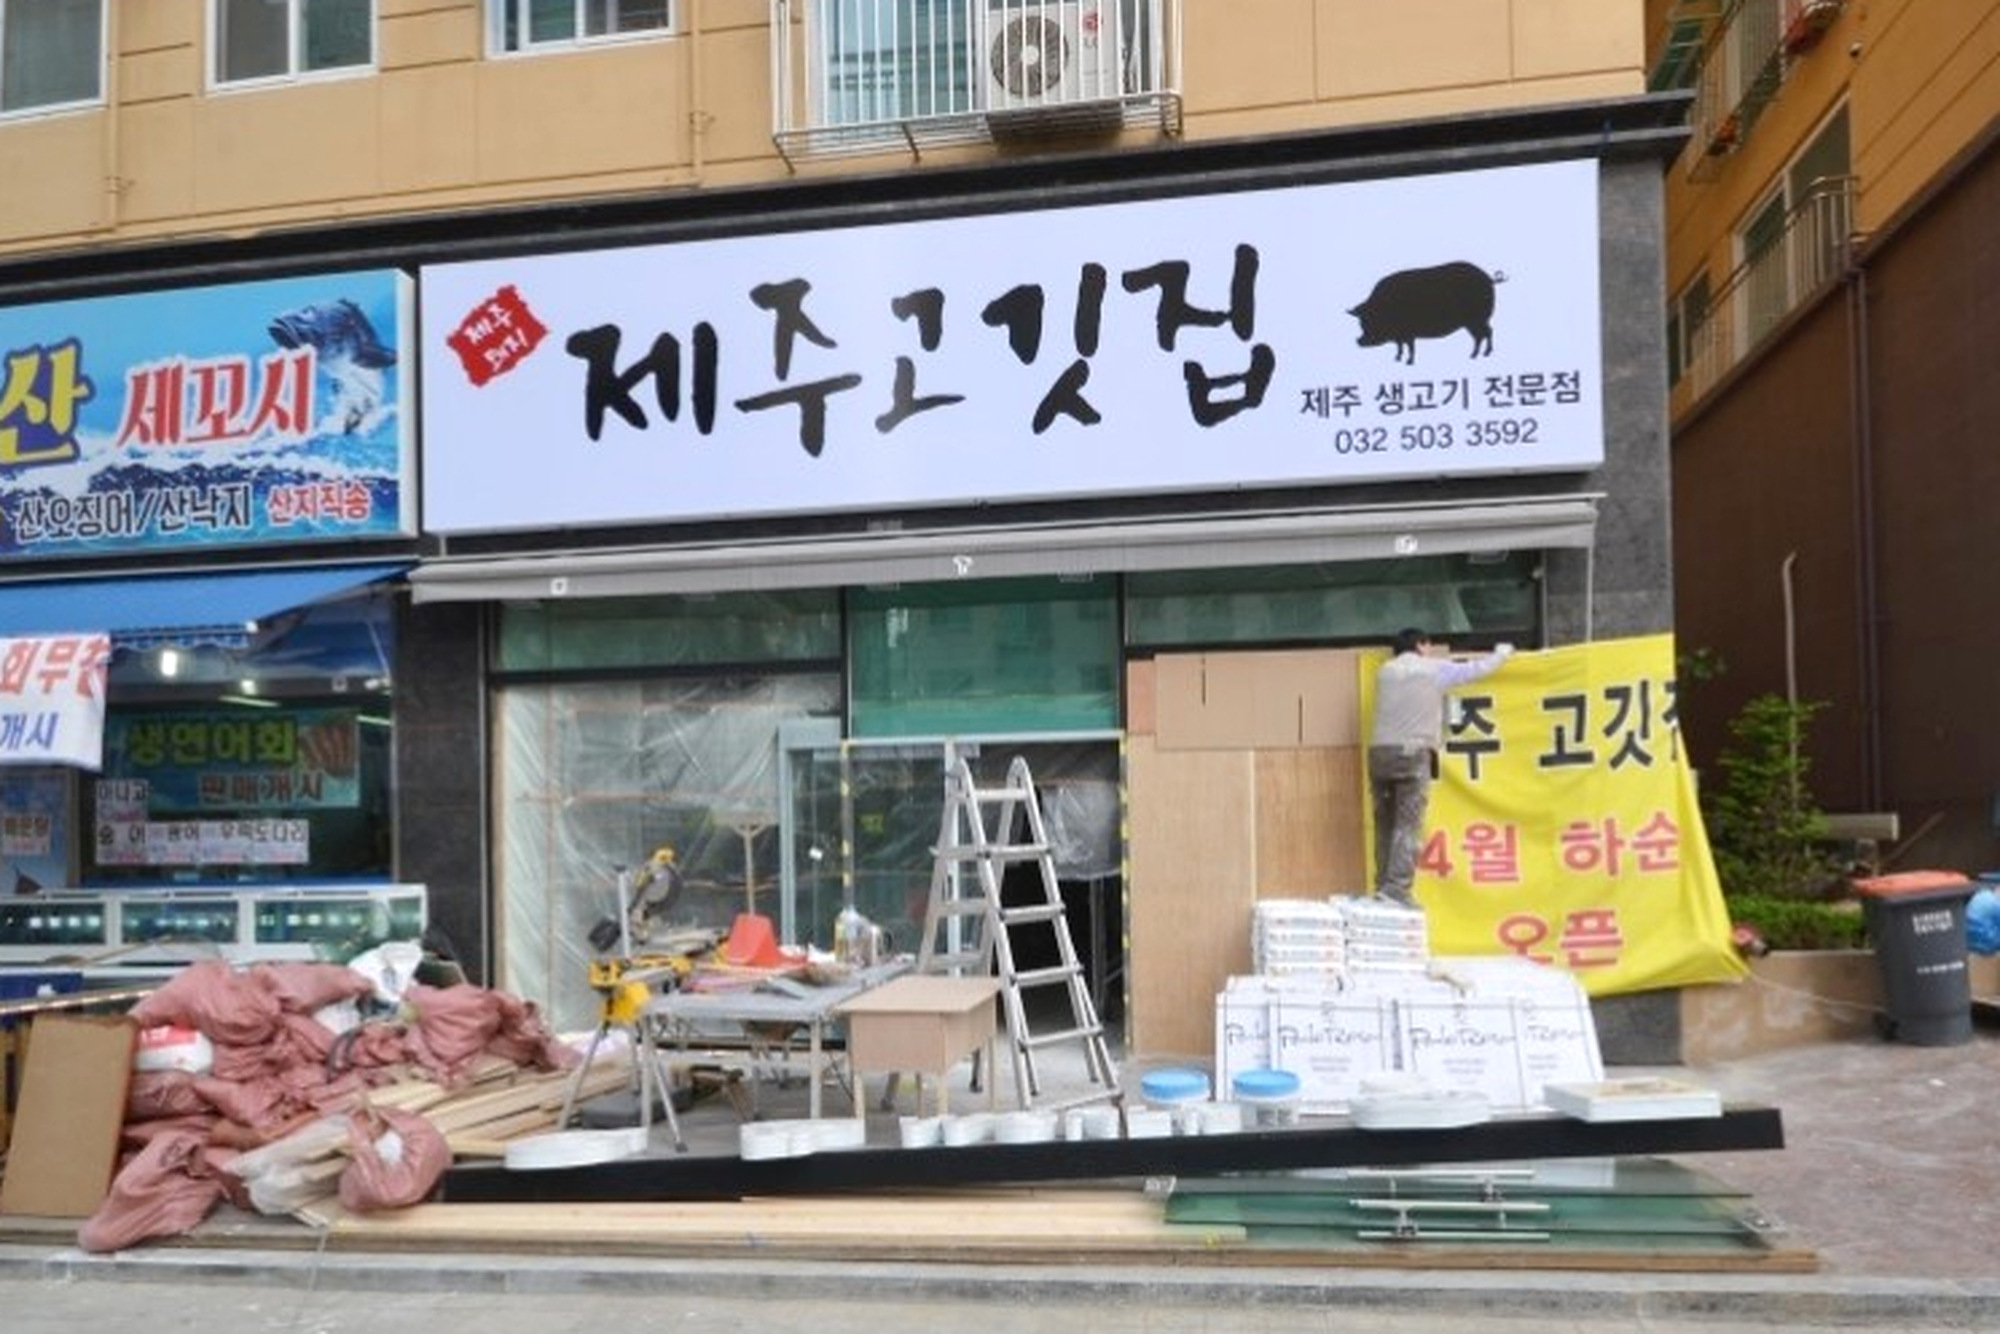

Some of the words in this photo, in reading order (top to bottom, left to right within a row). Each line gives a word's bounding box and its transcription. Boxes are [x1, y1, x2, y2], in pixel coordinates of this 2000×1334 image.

[464, 303, 513, 346] 제주
[566, 243, 1275, 457] 제주고깃집
[0, 338, 94, 466] 산
[116, 352, 315, 448] 세꼬시
[1300, 385, 1362, 418] 제주
[1375, 378, 1470, 415] 생고기
[1484, 370, 1581, 408] 전문점
[1335, 427, 1388, 454] 032
[1401, 423, 1453, 450] 503
[1466, 418, 1539, 447] 3592
[268, 484, 371, 524] 산지직송
[130, 719, 295, 766] 생연어회
[1421, 823, 1520, 884] 4월
[1561, 810, 1680, 876] 하순
[1498, 908, 1624, 968] 오픈
